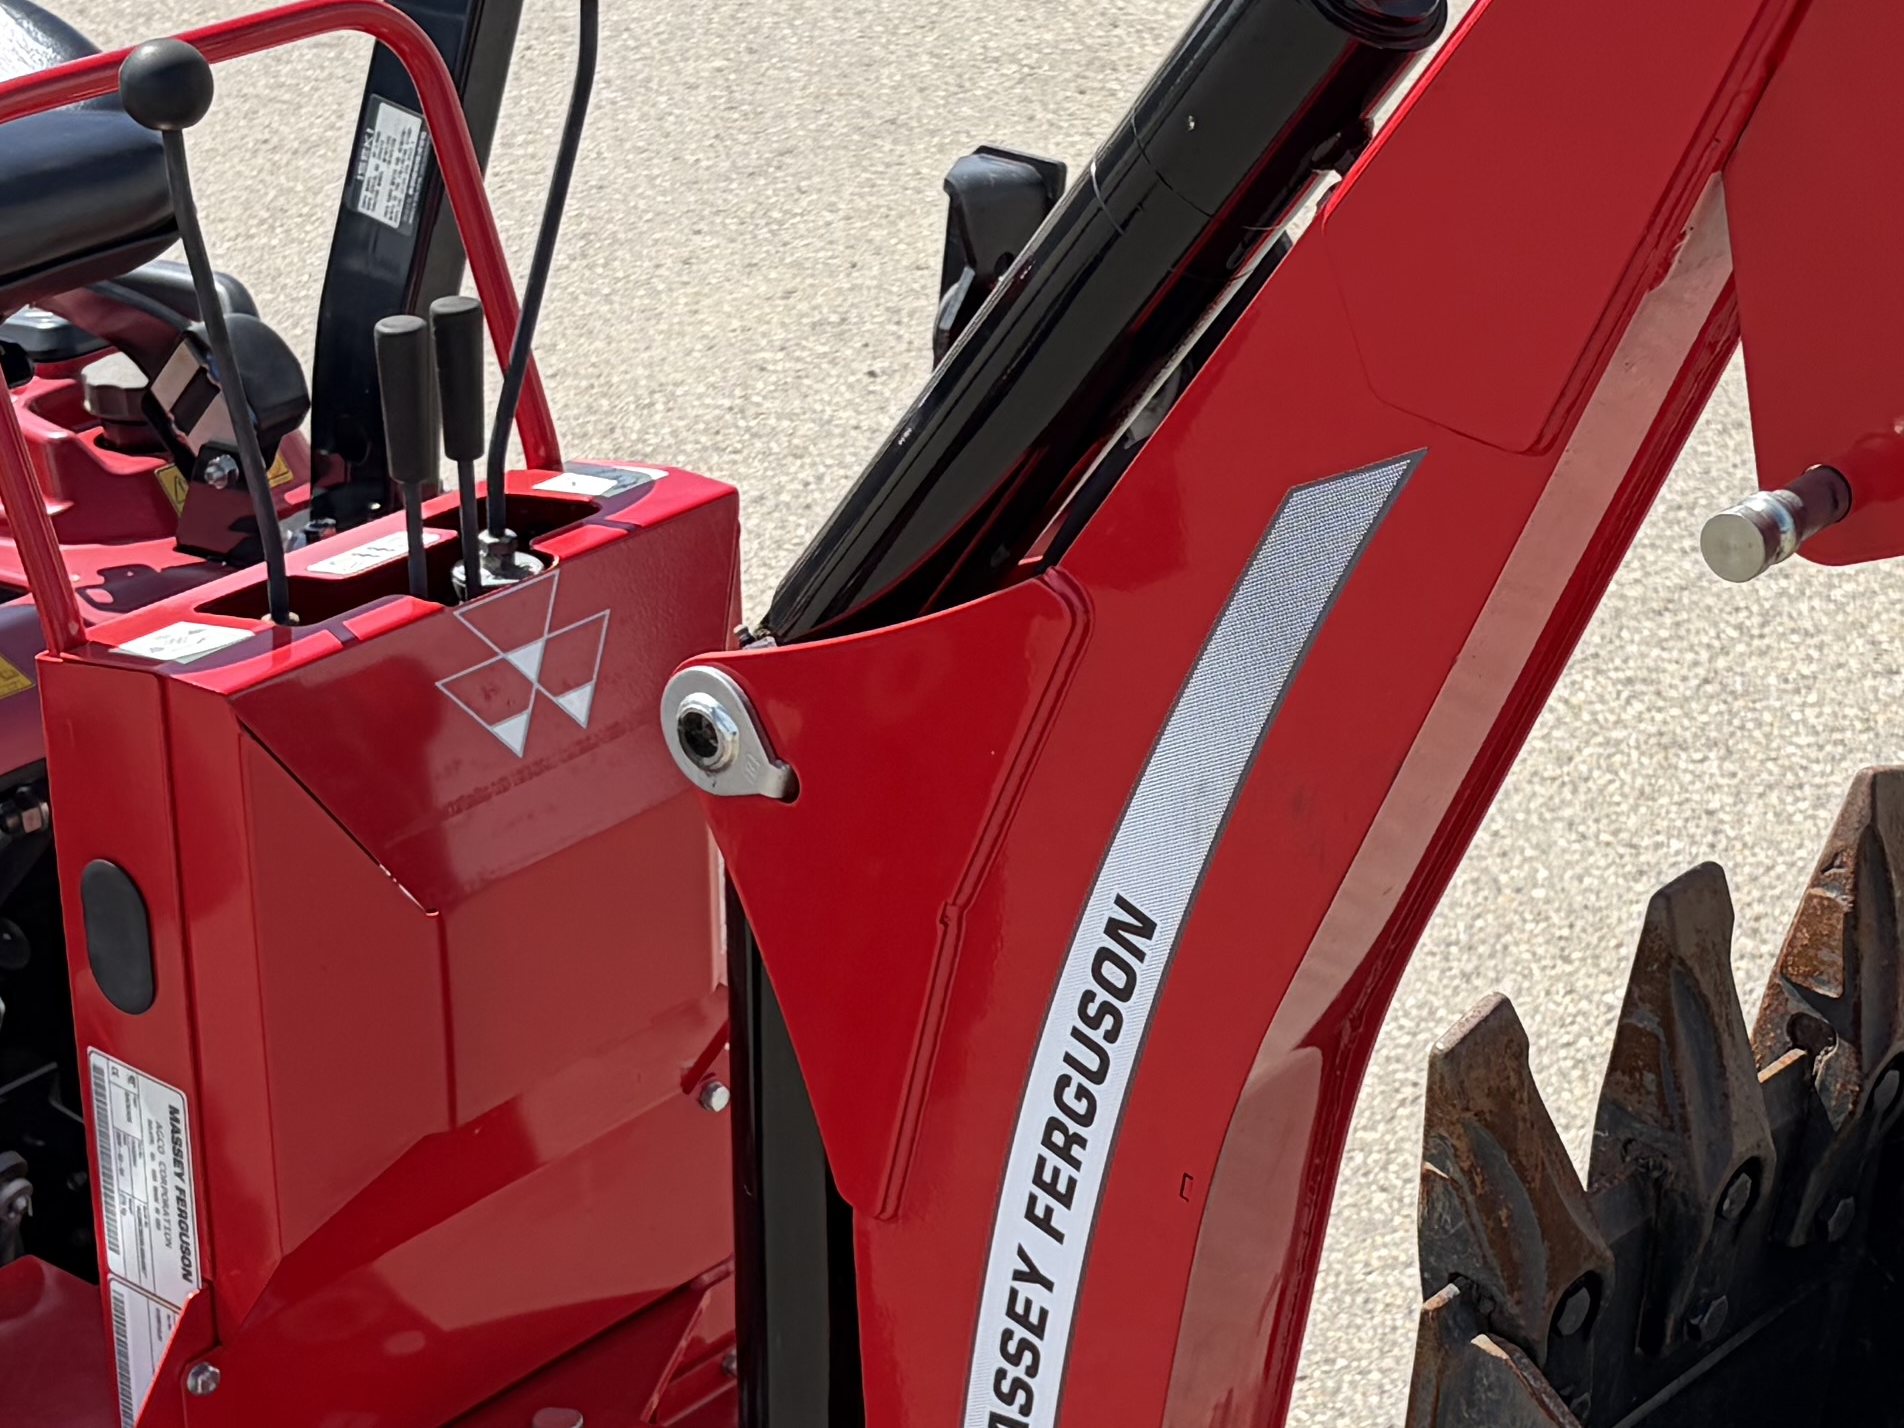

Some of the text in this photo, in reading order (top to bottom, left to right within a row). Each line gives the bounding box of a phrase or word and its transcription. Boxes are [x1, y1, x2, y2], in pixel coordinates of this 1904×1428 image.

[1025, 891, 1158, 1248] FERGUSON
[155, 1120, 173, 1251] AGCO CORPORATION
[167, 1103, 194, 1285] MASSEY FERGUSON
